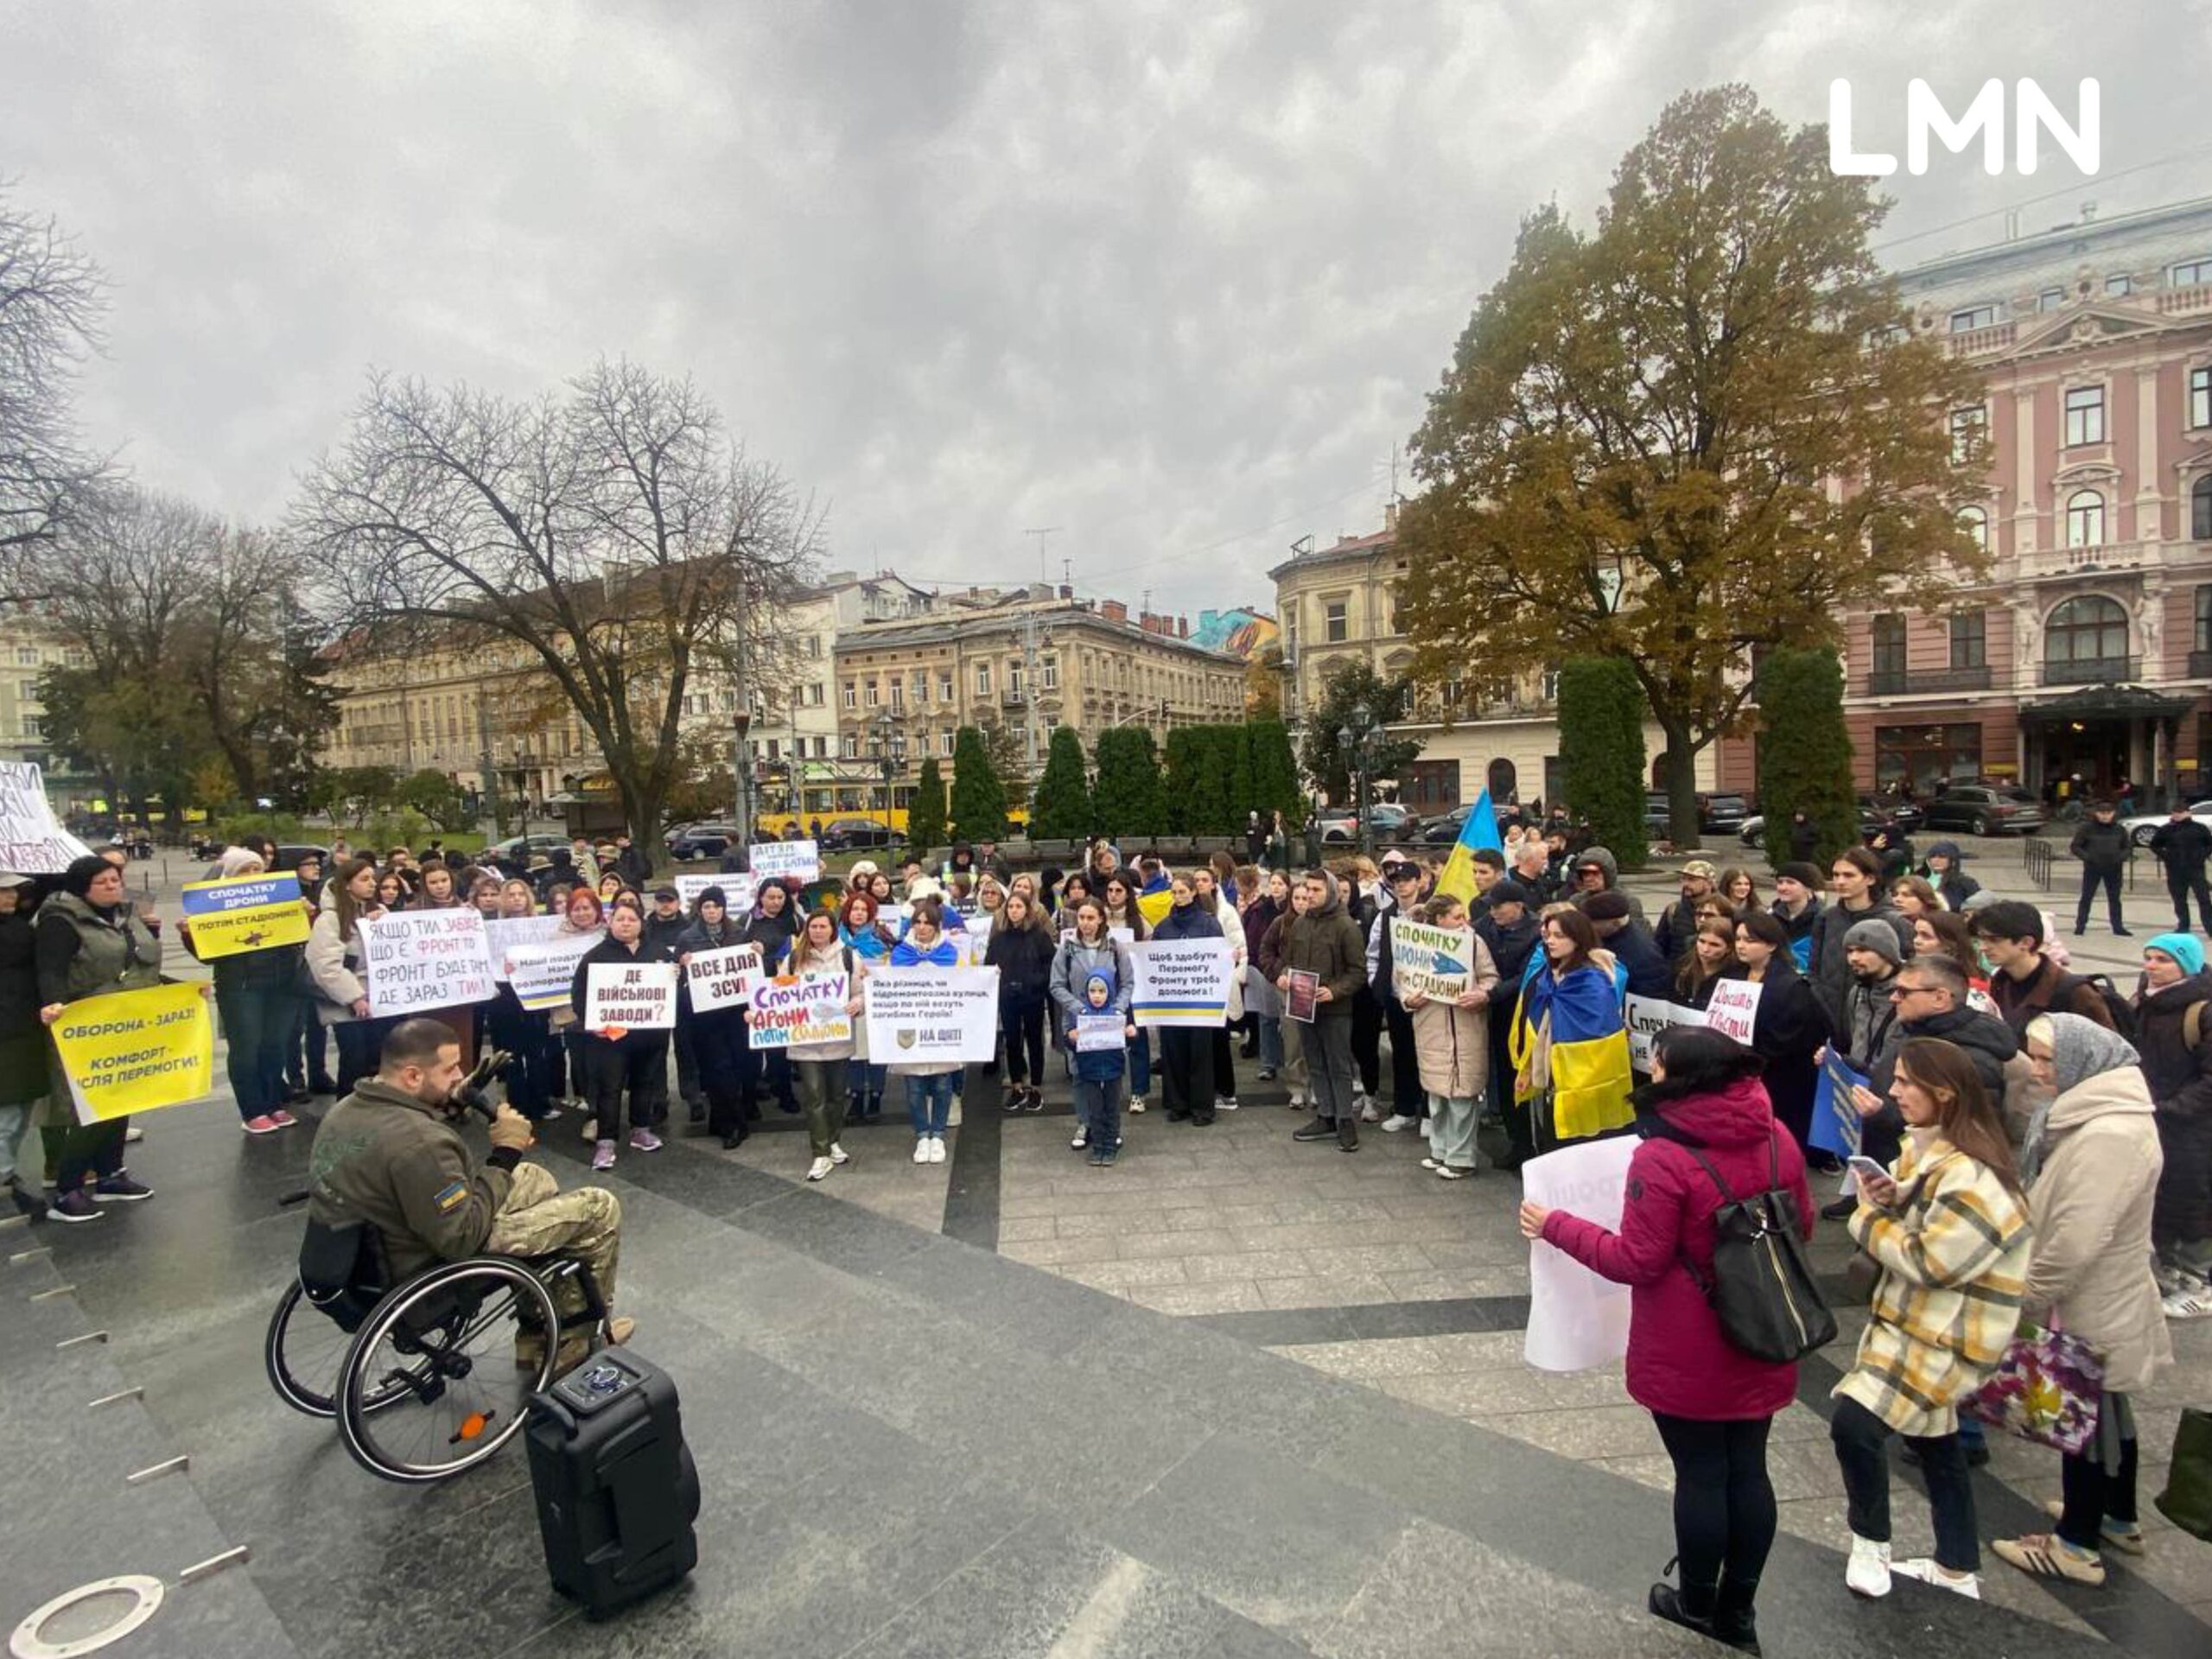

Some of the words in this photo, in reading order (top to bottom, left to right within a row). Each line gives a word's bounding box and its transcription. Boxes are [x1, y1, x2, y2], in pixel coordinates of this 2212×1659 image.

[207, 882, 276, 899] СПОЧАТКУ
[224, 894, 270, 909] ДРОНИ
[197, 918, 234, 931] ПОТІМ
[369, 920, 410, 940] ЯКЩО
[413, 918, 442, 935] ТИЛ
[1395, 924, 1462, 951] СПОЧАТКУ
[371, 944, 393, 962] ЩО
[398, 942, 410, 957] Є
[416, 938, 460, 955] ФРОНТ
[375, 963, 428, 983] ФРОНТ
[435, 960, 467, 978] БУДЕ
[625, 969, 642, 983] ДЕ
[692, 960, 721, 979] ВСЕ
[724, 953, 758, 976] ДЛЯ
[1158, 964, 1210, 974] Перемогу
[710, 977, 747, 998] ЗСУ!
[1148, 976, 1187, 985] Фронту
[1191, 976, 1220, 985] треба
[378, 989, 399, 1005] ДЕ
[404, 983, 449, 1005] ЗАРАЗ
[597, 985, 666, 1001] ВІЙСЬКОВІ
[600, 1004, 664, 1023] ЗАВОДИ?
[61, 1018, 145, 1039] ОБОРОНА
[919, 1028, 935, 1042] НА
[90, 1046, 167, 1071] КОМФОРТ
[1635, 1046, 1648, 1058] НЕ
[117, 1056, 200, 1084] ПЕРЕМОГИ!
